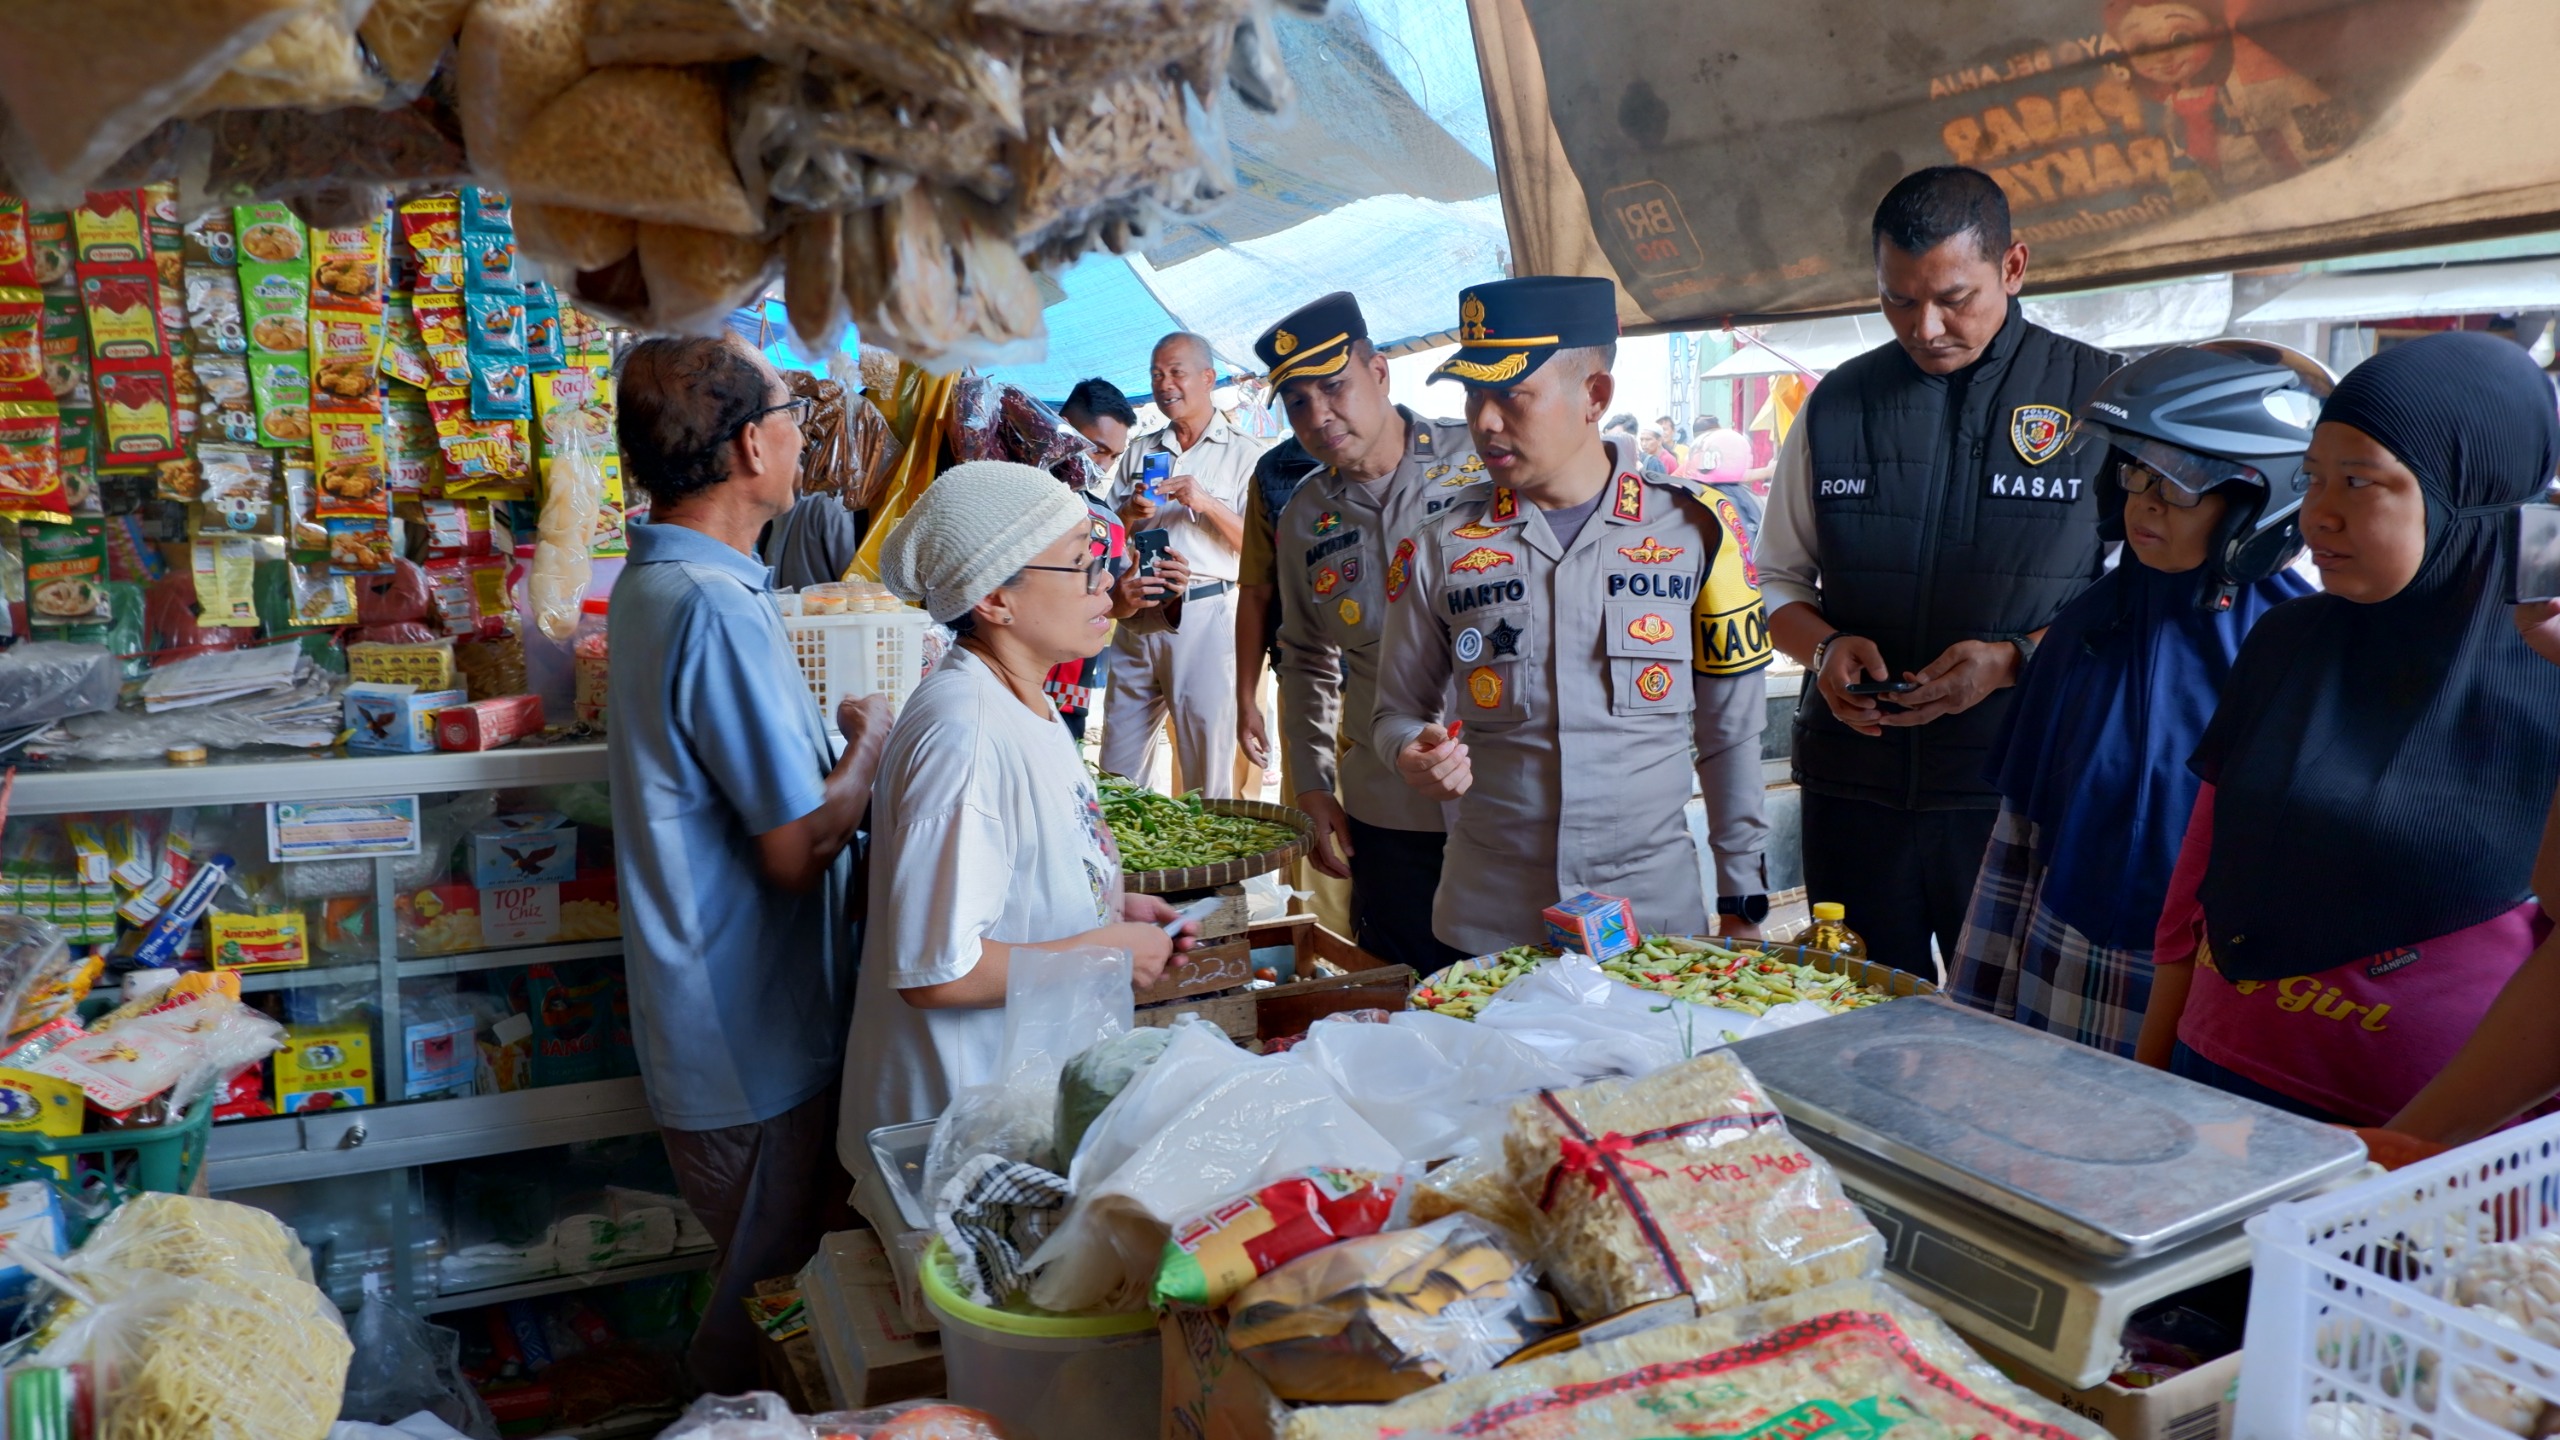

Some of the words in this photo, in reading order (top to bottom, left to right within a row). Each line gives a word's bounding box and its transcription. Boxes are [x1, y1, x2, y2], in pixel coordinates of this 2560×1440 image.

[328, 229, 369, 245] Racik
[327, 331, 369, 349] Racik
[1671, 336, 1684, 425] JAMU
[2090, 401, 2129, 420] HONDA
[331, 433, 370, 450] Racik
[1821, 478, 1866, 496] RONI
[1992, 473, 2082, 499] KASAT
[1447, 579, 1525, 615] HARTO
[1608, 574, 1692, 600] POLRI
[493, 886, 536, 910] TOP
[509, 903, 544, 921] Chiz
[223, 928, 278, 939] Antangin
[1178, 957, 1247, 988] 220
[2371, 952, 2418, 976] CHAMPION
[2276, 976, 2392, 1032] Girl
